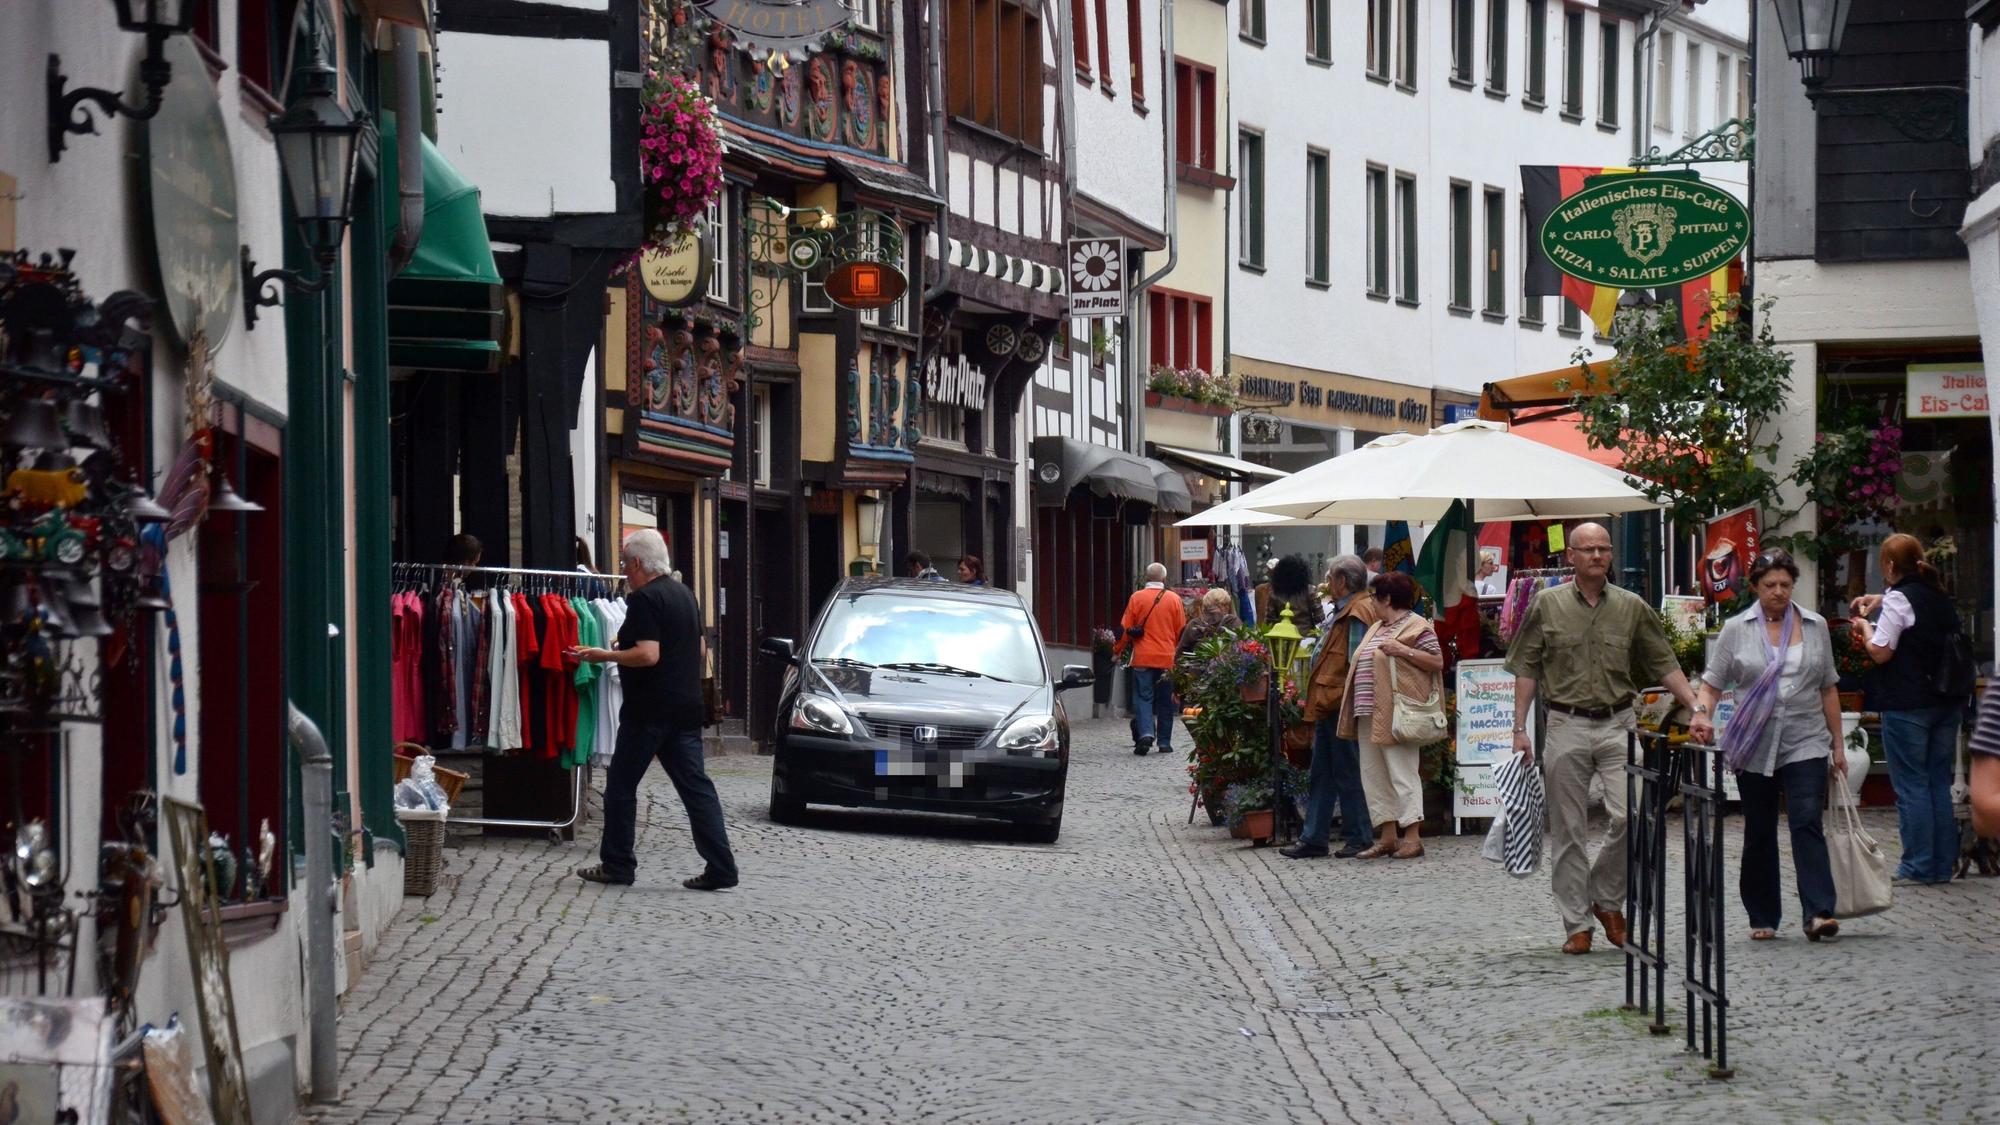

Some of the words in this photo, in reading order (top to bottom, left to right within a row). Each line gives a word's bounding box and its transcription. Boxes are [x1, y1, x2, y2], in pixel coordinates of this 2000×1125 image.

[726, 1, 827, 33] HOTEL
[1560, 185, 1657, 223] Italienisches
[1660, 184, 1729, 214] Eis-Café
[1563, 229, 1611, 241] CARLO
[1680, 222, 1729, 234] PITTAU
[1552, 244, 1593, 272] PIZZA
[1608, 266, 1669, 280] SALATE
[1683, 234, 1740, 272] SUPPEN
[1091, 296, 1120, 308] Platz
[956, 354, 986, 411] Platz
